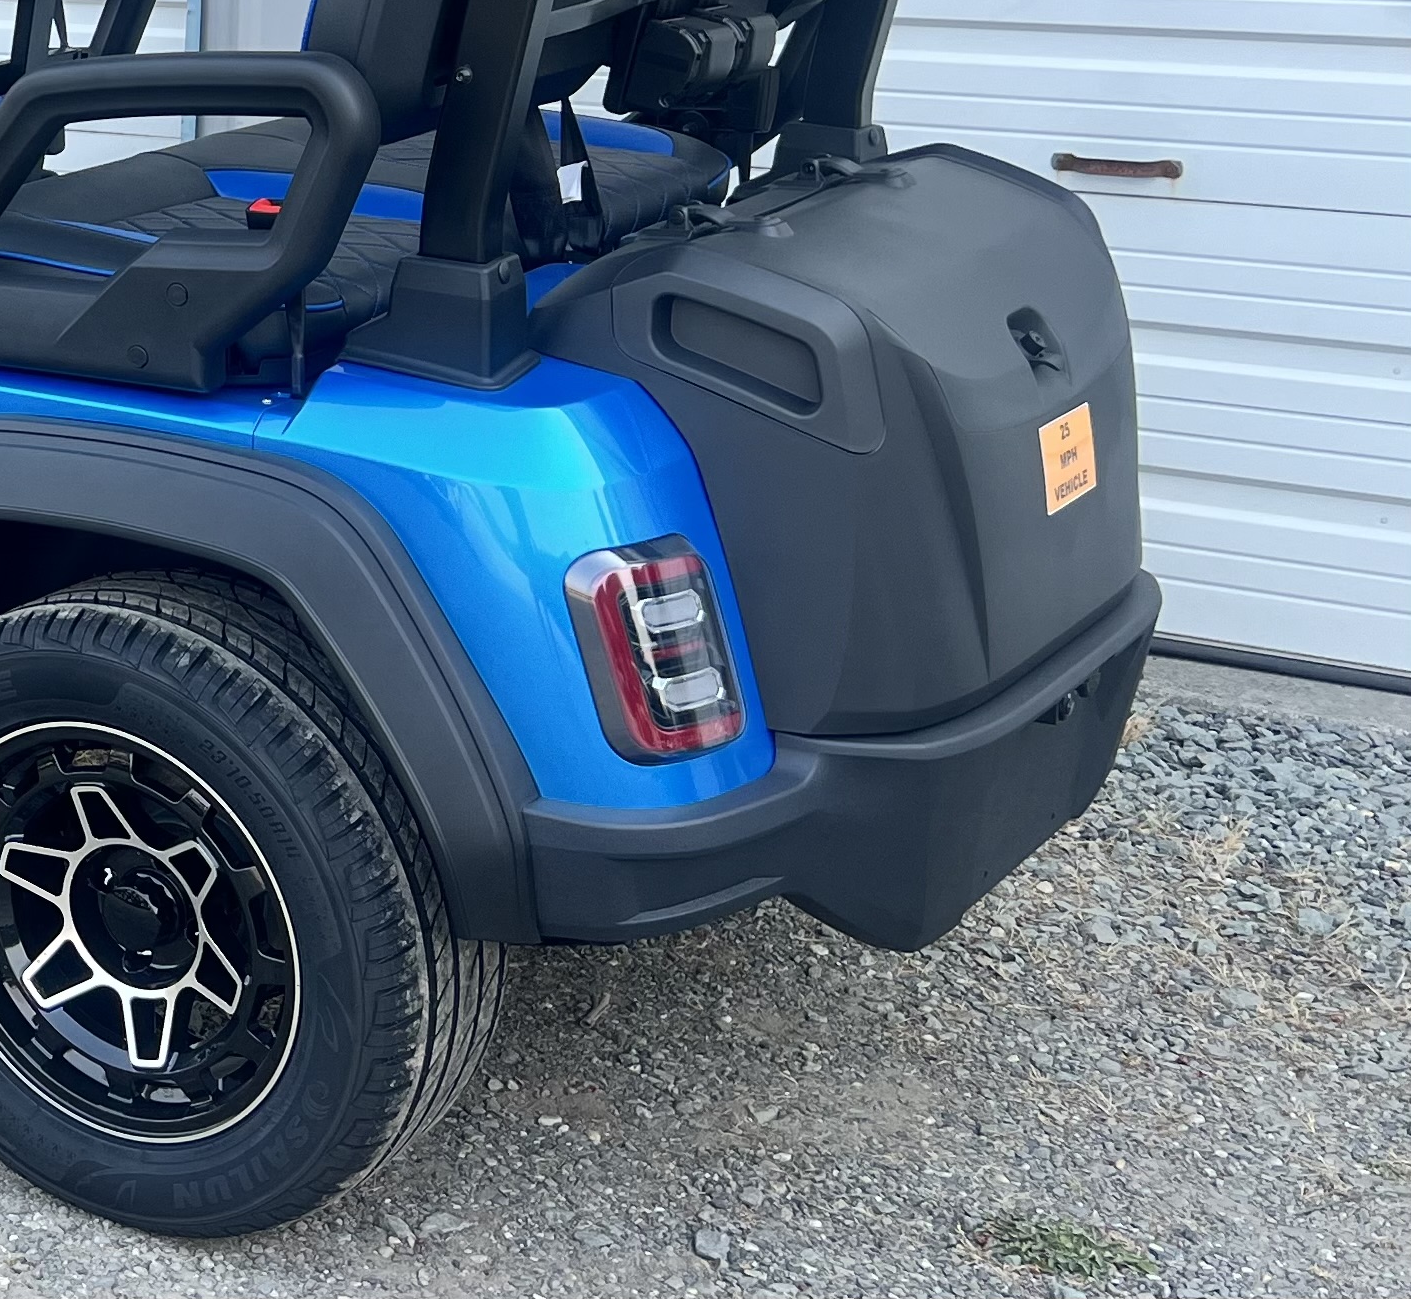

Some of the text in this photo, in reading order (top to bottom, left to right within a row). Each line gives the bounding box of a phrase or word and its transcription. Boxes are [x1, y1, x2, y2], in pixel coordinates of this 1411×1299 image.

[1059, 421, 1071, 440] 25
[1060, 446, 1077, 469] MPH
[1054, 469, 1088, 501] VEHICLE
[172, 1114, 310, 1210] SAILUN
